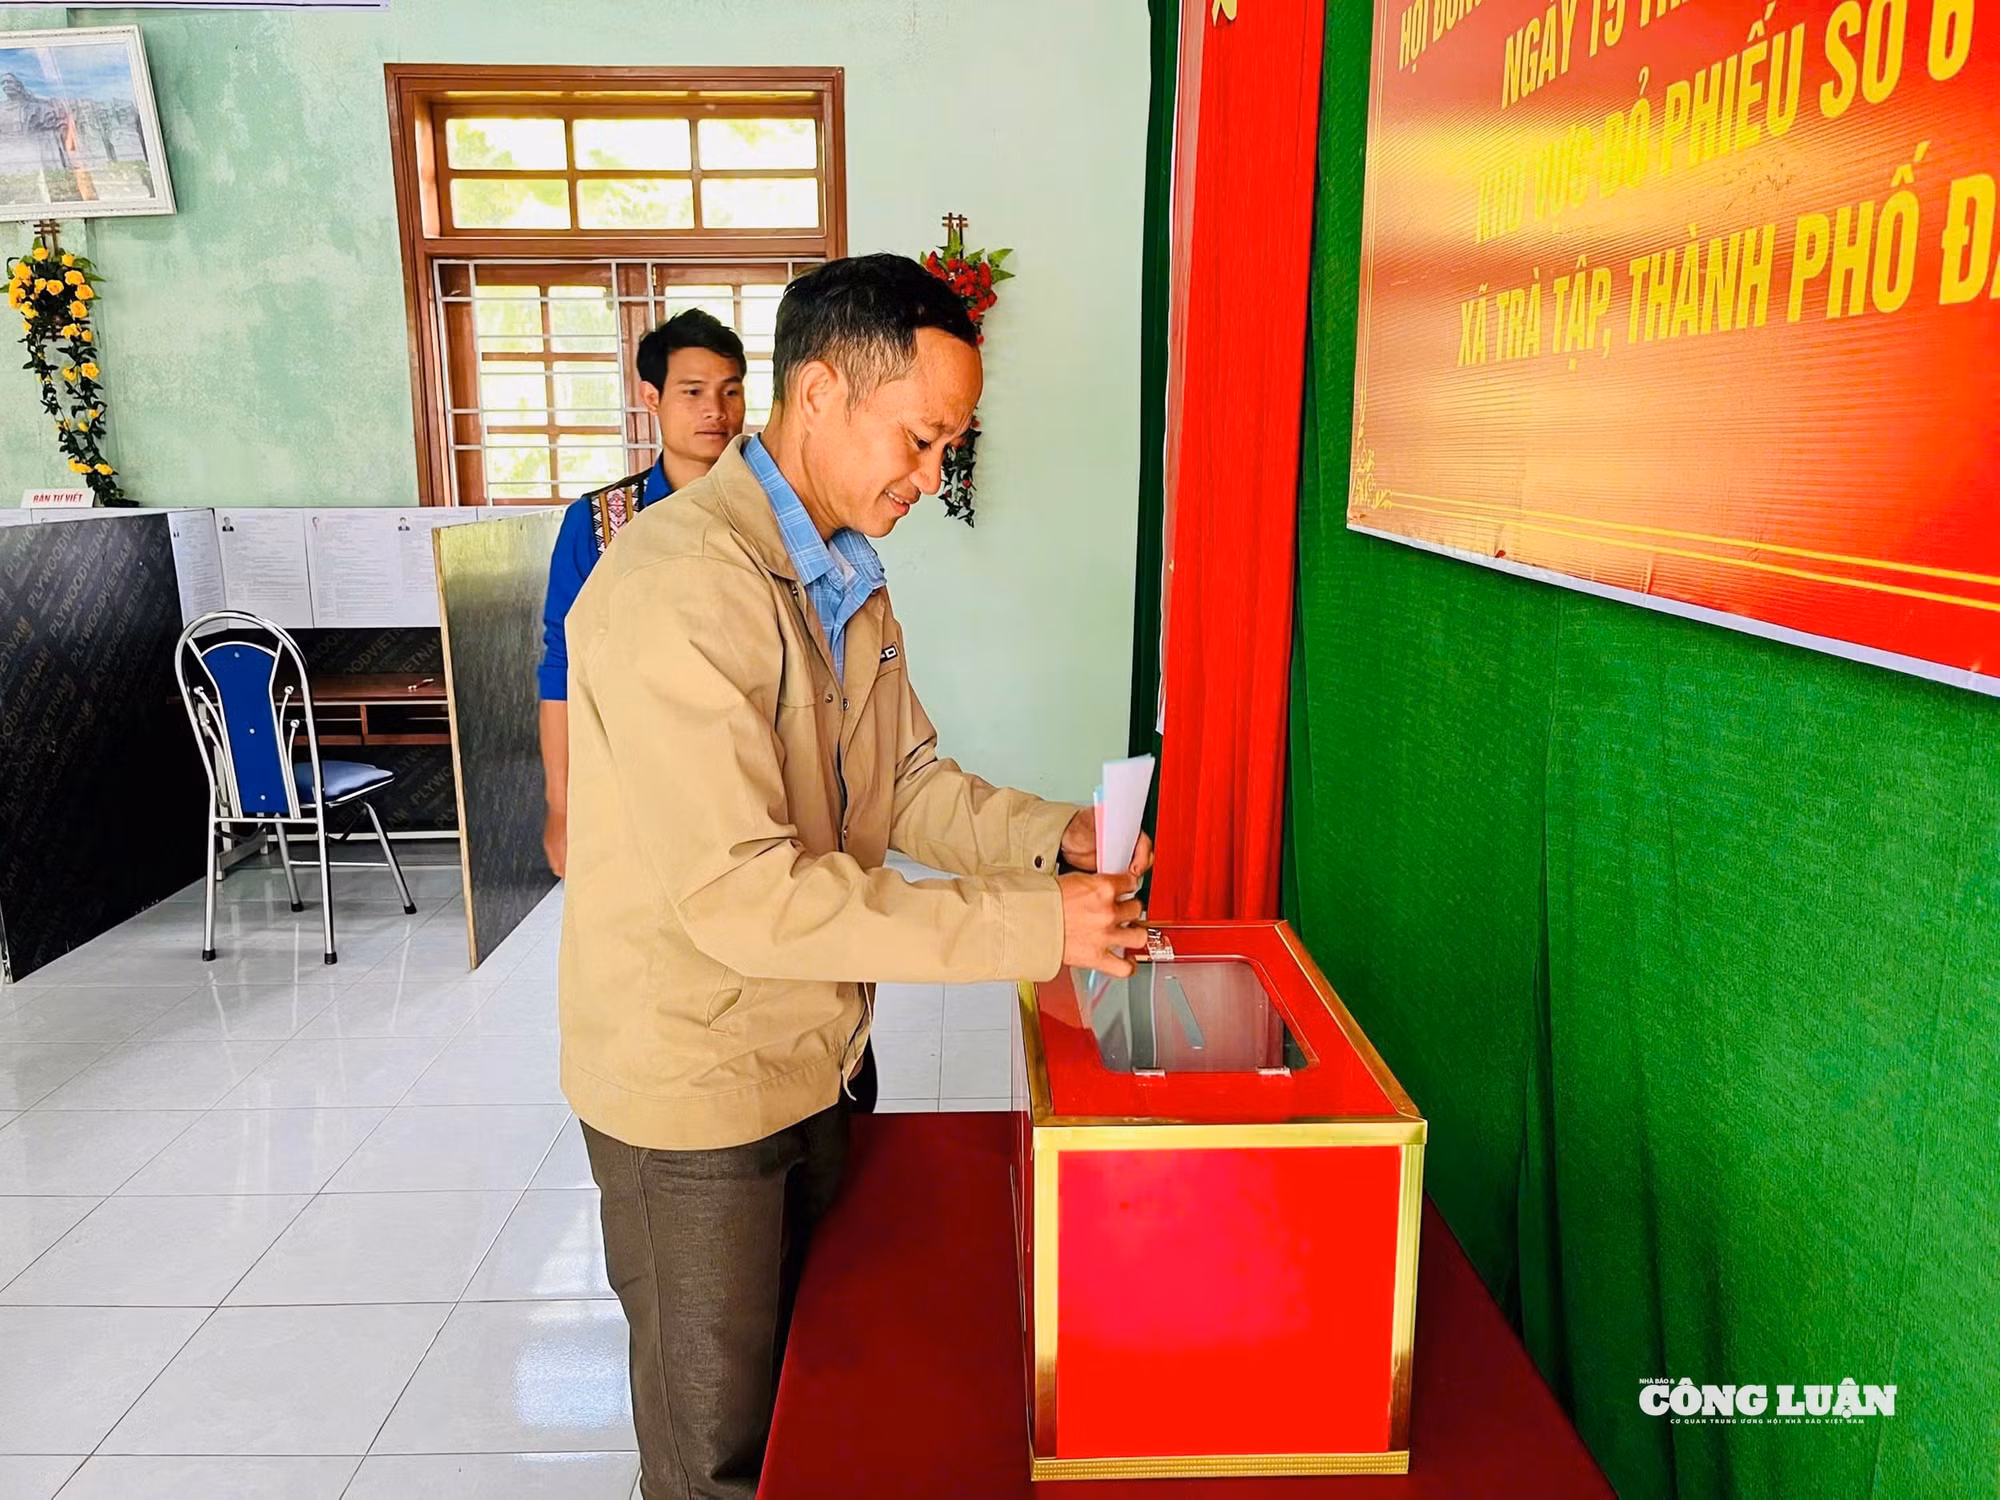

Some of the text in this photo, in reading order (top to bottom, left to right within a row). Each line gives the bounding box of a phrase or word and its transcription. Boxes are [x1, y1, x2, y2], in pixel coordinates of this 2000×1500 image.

[1660, 1, 1805, 176] PHIẾU
[1457, 140, 2000, 370] XÃ TRÀ TẬP, THÀNH PHỐ Đ
